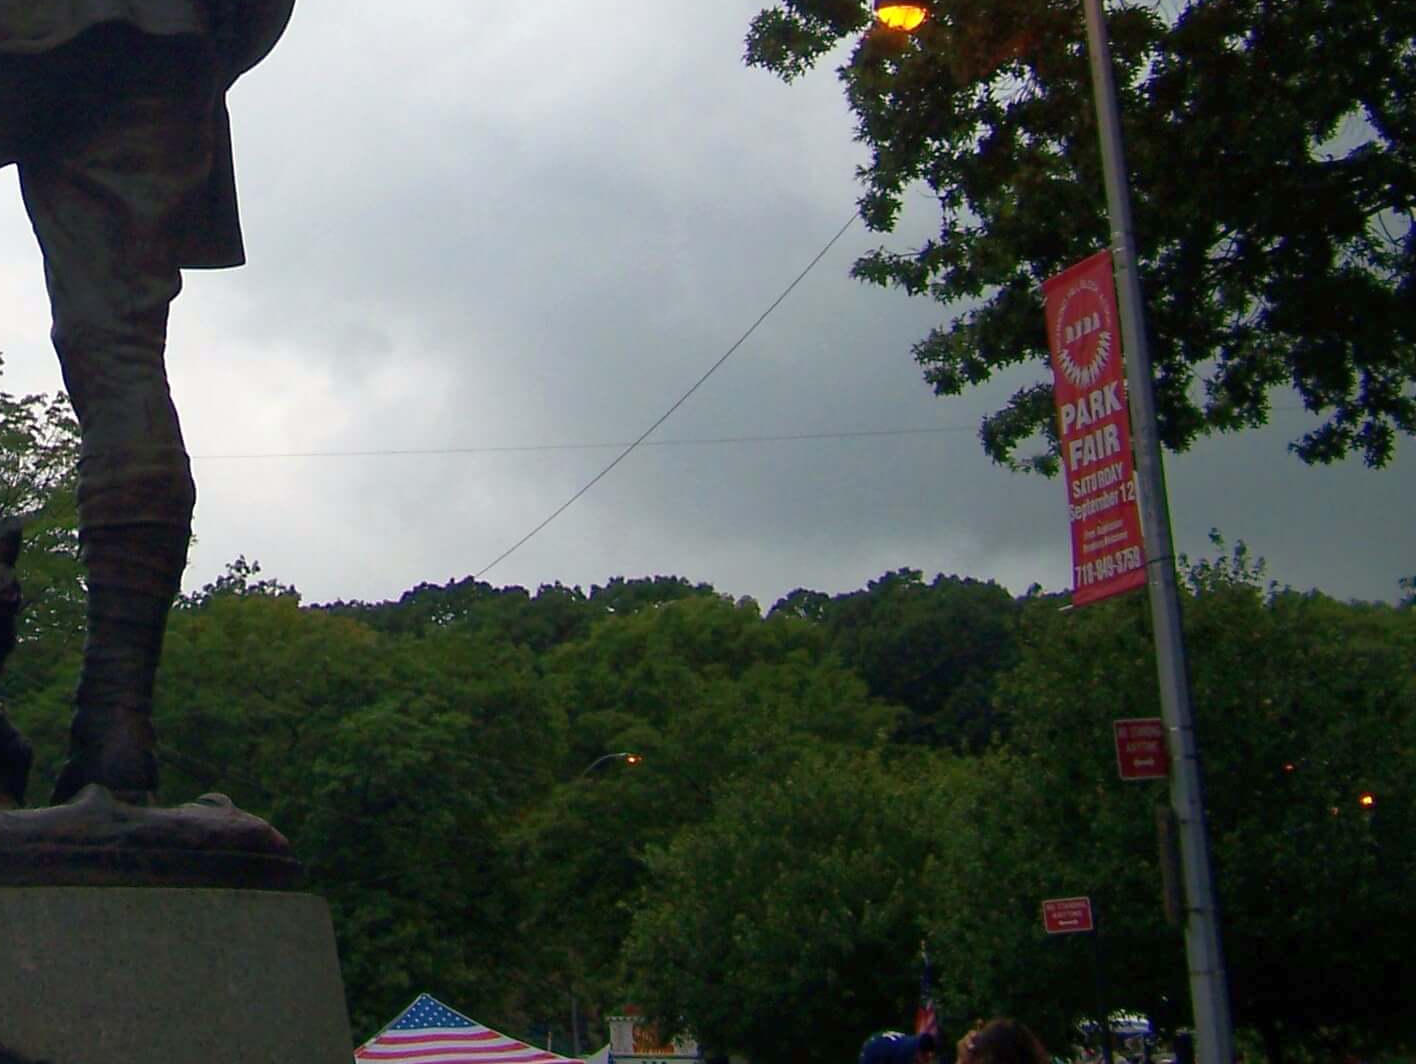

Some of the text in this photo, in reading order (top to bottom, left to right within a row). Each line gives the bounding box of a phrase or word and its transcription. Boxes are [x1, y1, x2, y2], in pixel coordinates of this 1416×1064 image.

[1060, 379, 1122, 434] PARK
[1069, 423, 1121, 472] FAIR
[1068, 481, 1137, 522] September 12
[1072, 461, 1124, 499] SATURDAY
